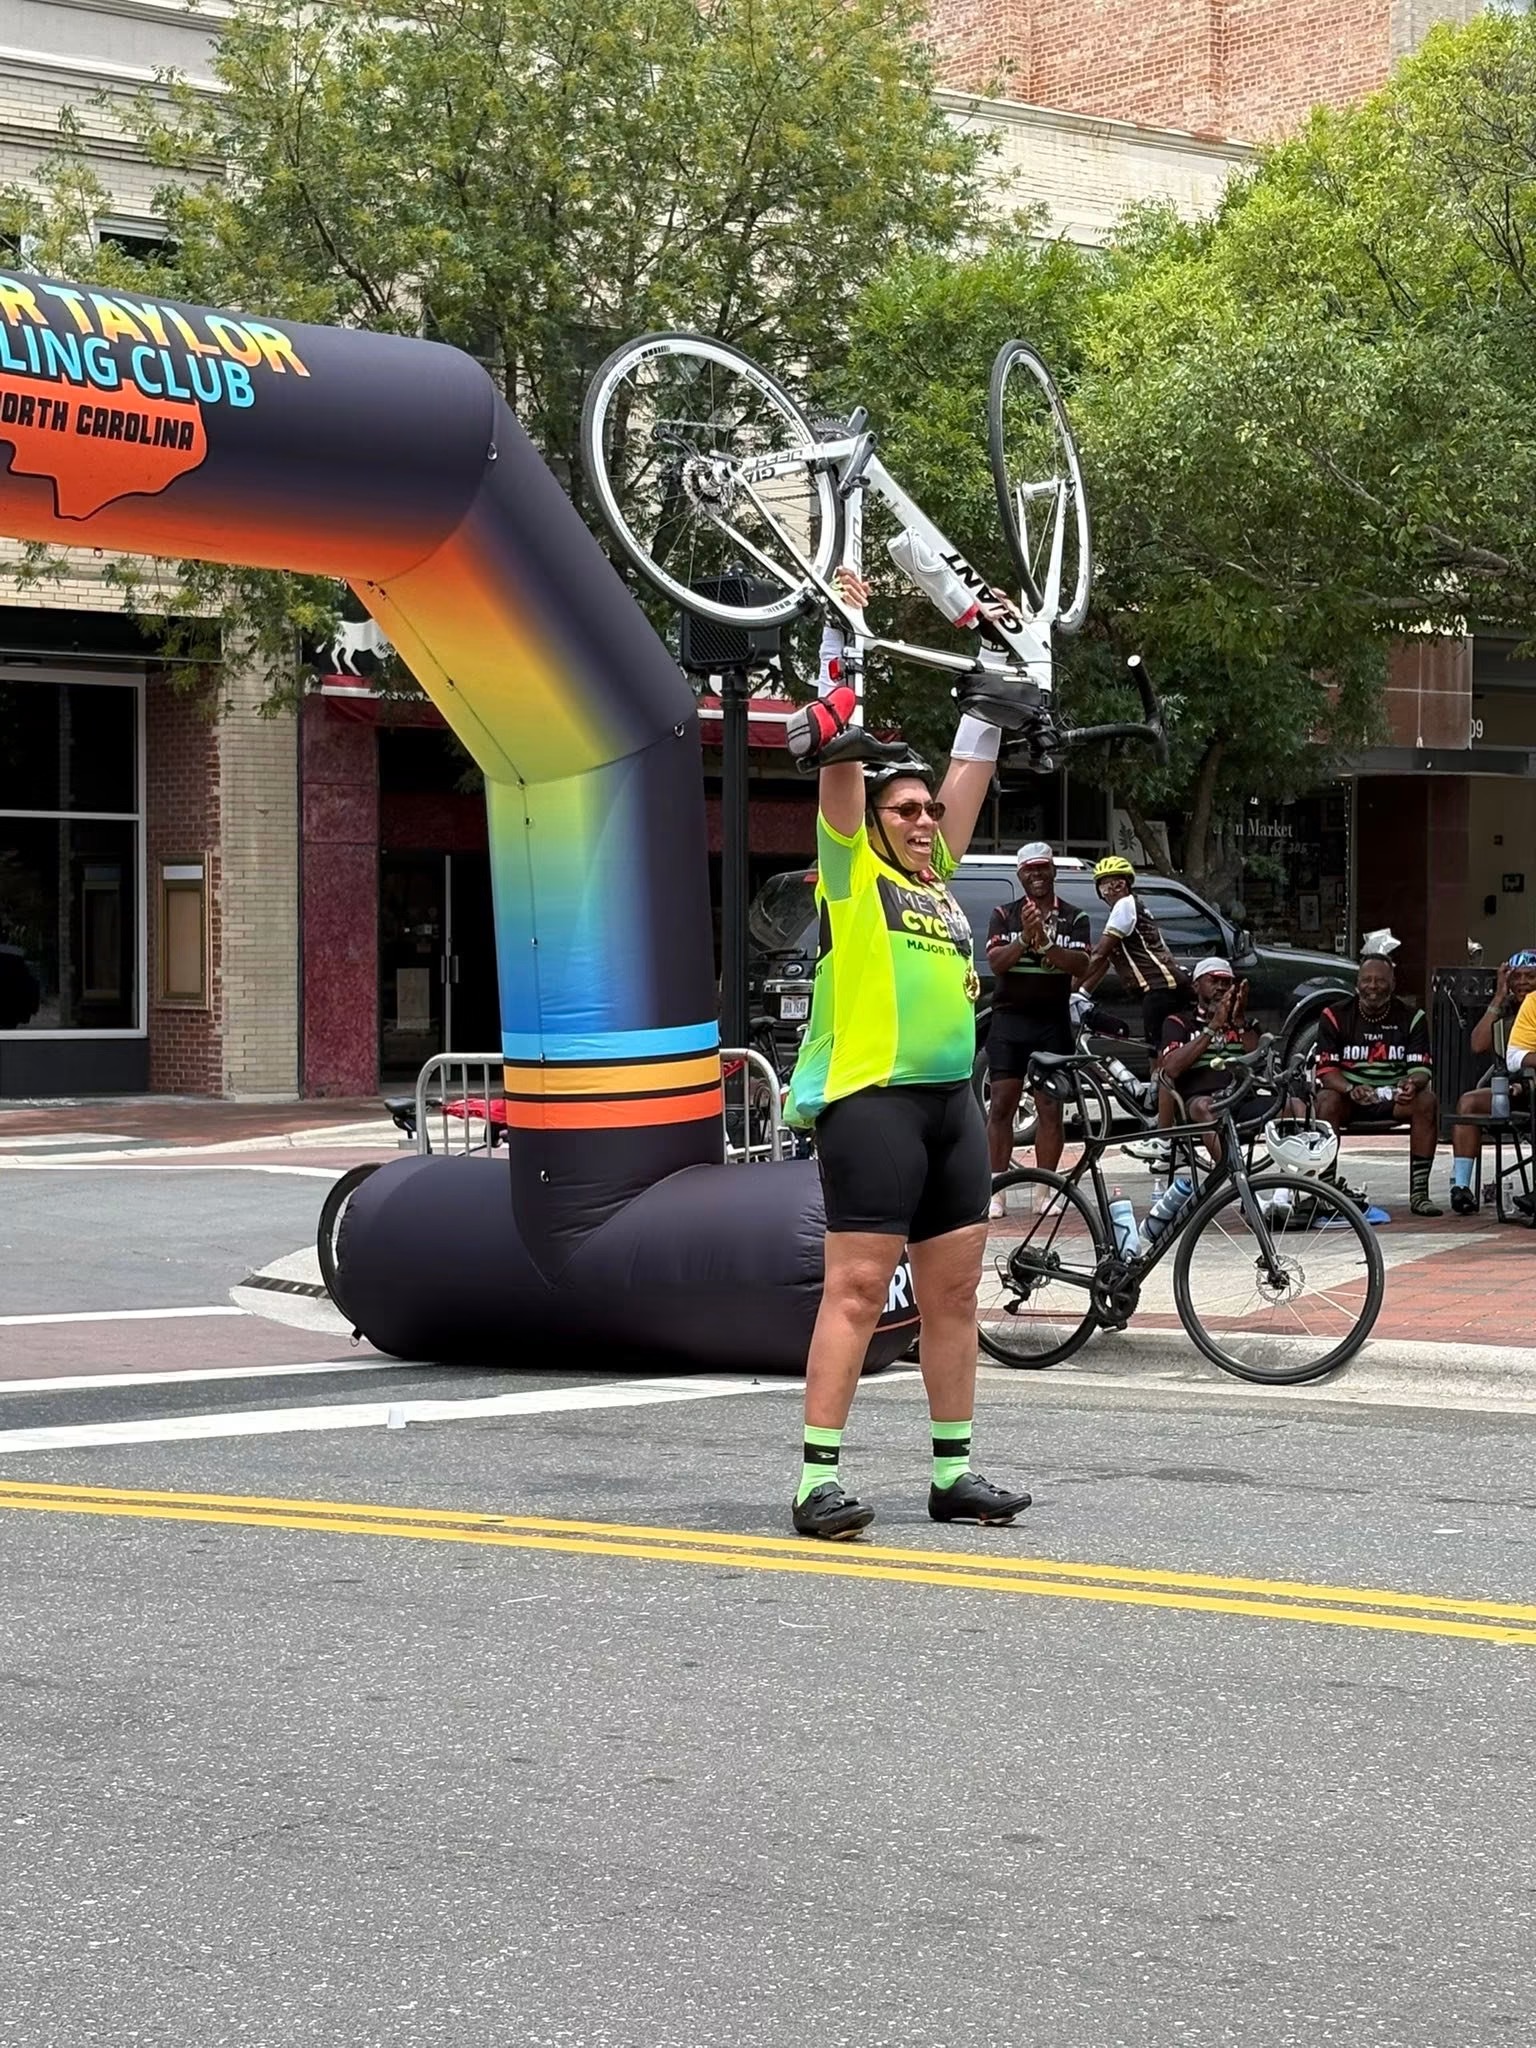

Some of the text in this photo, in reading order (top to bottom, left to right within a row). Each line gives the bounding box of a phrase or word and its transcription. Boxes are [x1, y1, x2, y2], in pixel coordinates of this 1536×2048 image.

[37, 283, 311, 378] TAYLOR
[131, 345, 256, 409] CLUB
[0, 391, 195, 452] ORTH CAROLINA
[1247, 818, 1293, 838] Market
[901, 909, 949, 938] CYC
[906, 939, 946, 956] MAJOR
